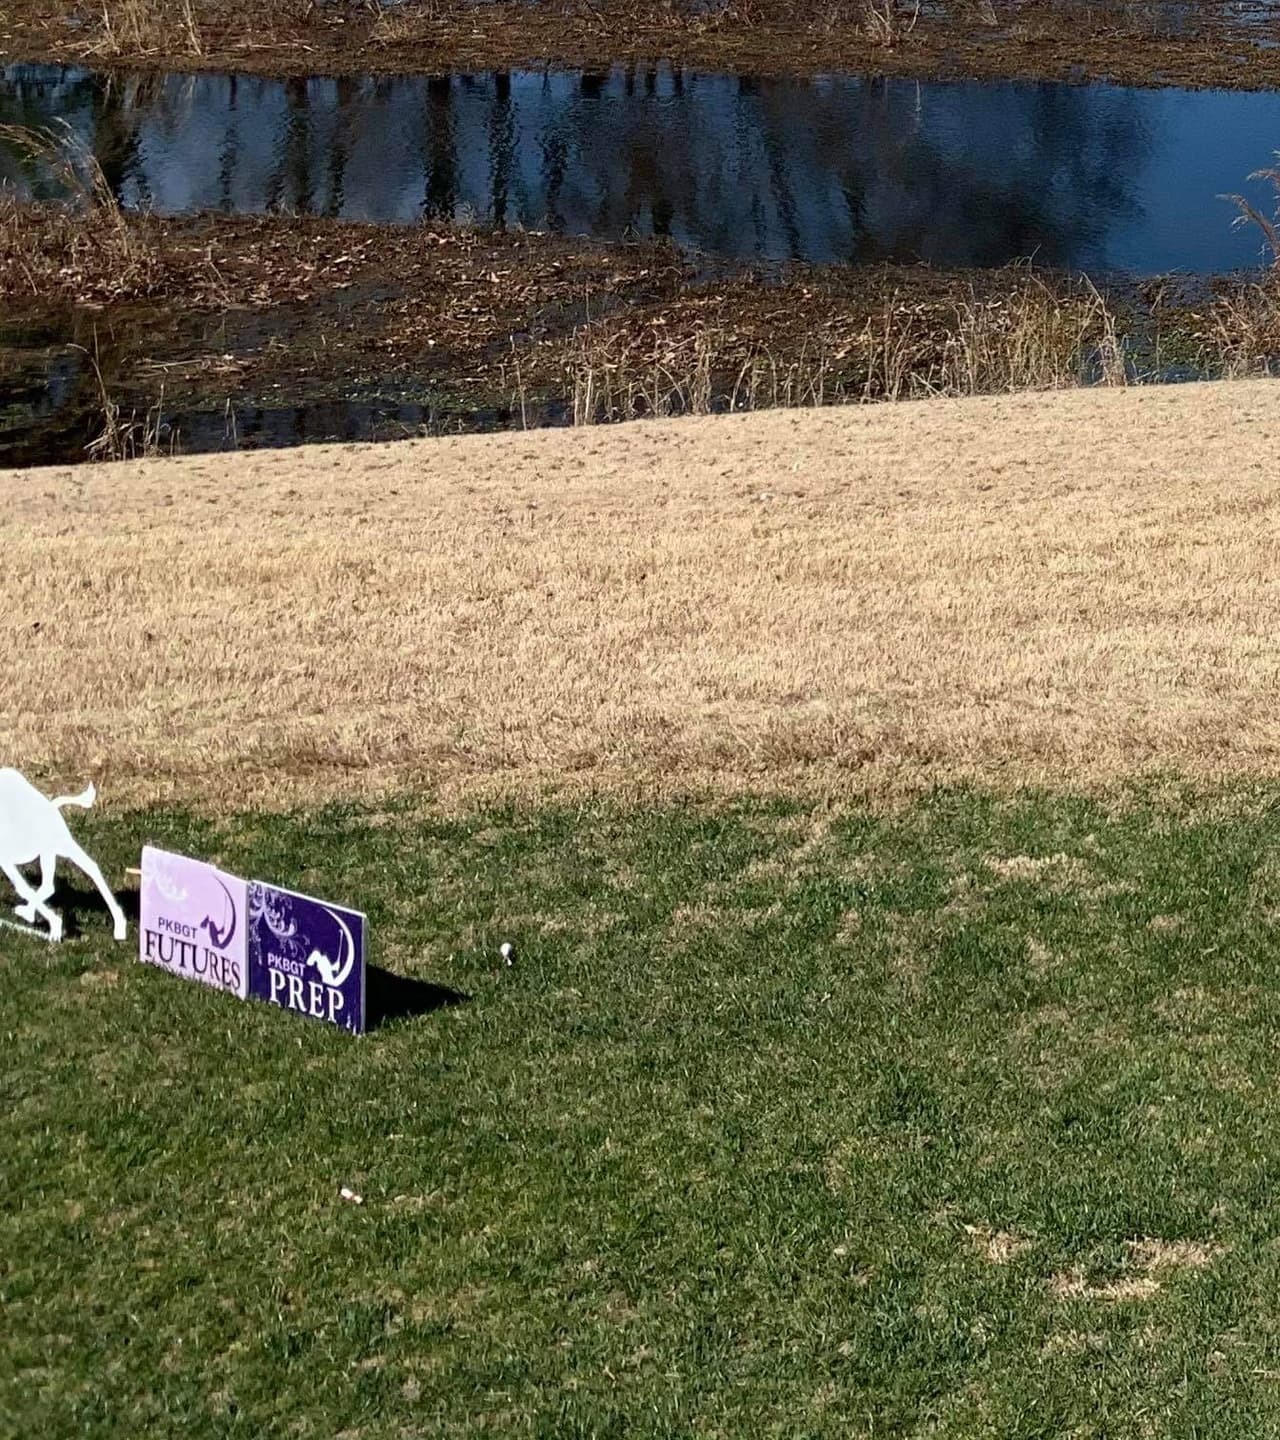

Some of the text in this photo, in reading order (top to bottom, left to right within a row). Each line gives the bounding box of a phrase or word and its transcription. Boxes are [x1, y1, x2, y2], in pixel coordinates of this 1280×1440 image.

[158, 916, 198, 941] PKBGT
[144, 929, 240, 990] FUTURES
[267, 952, 306, 977] PKBGT
[268, 968, 344, 1023] PREP
